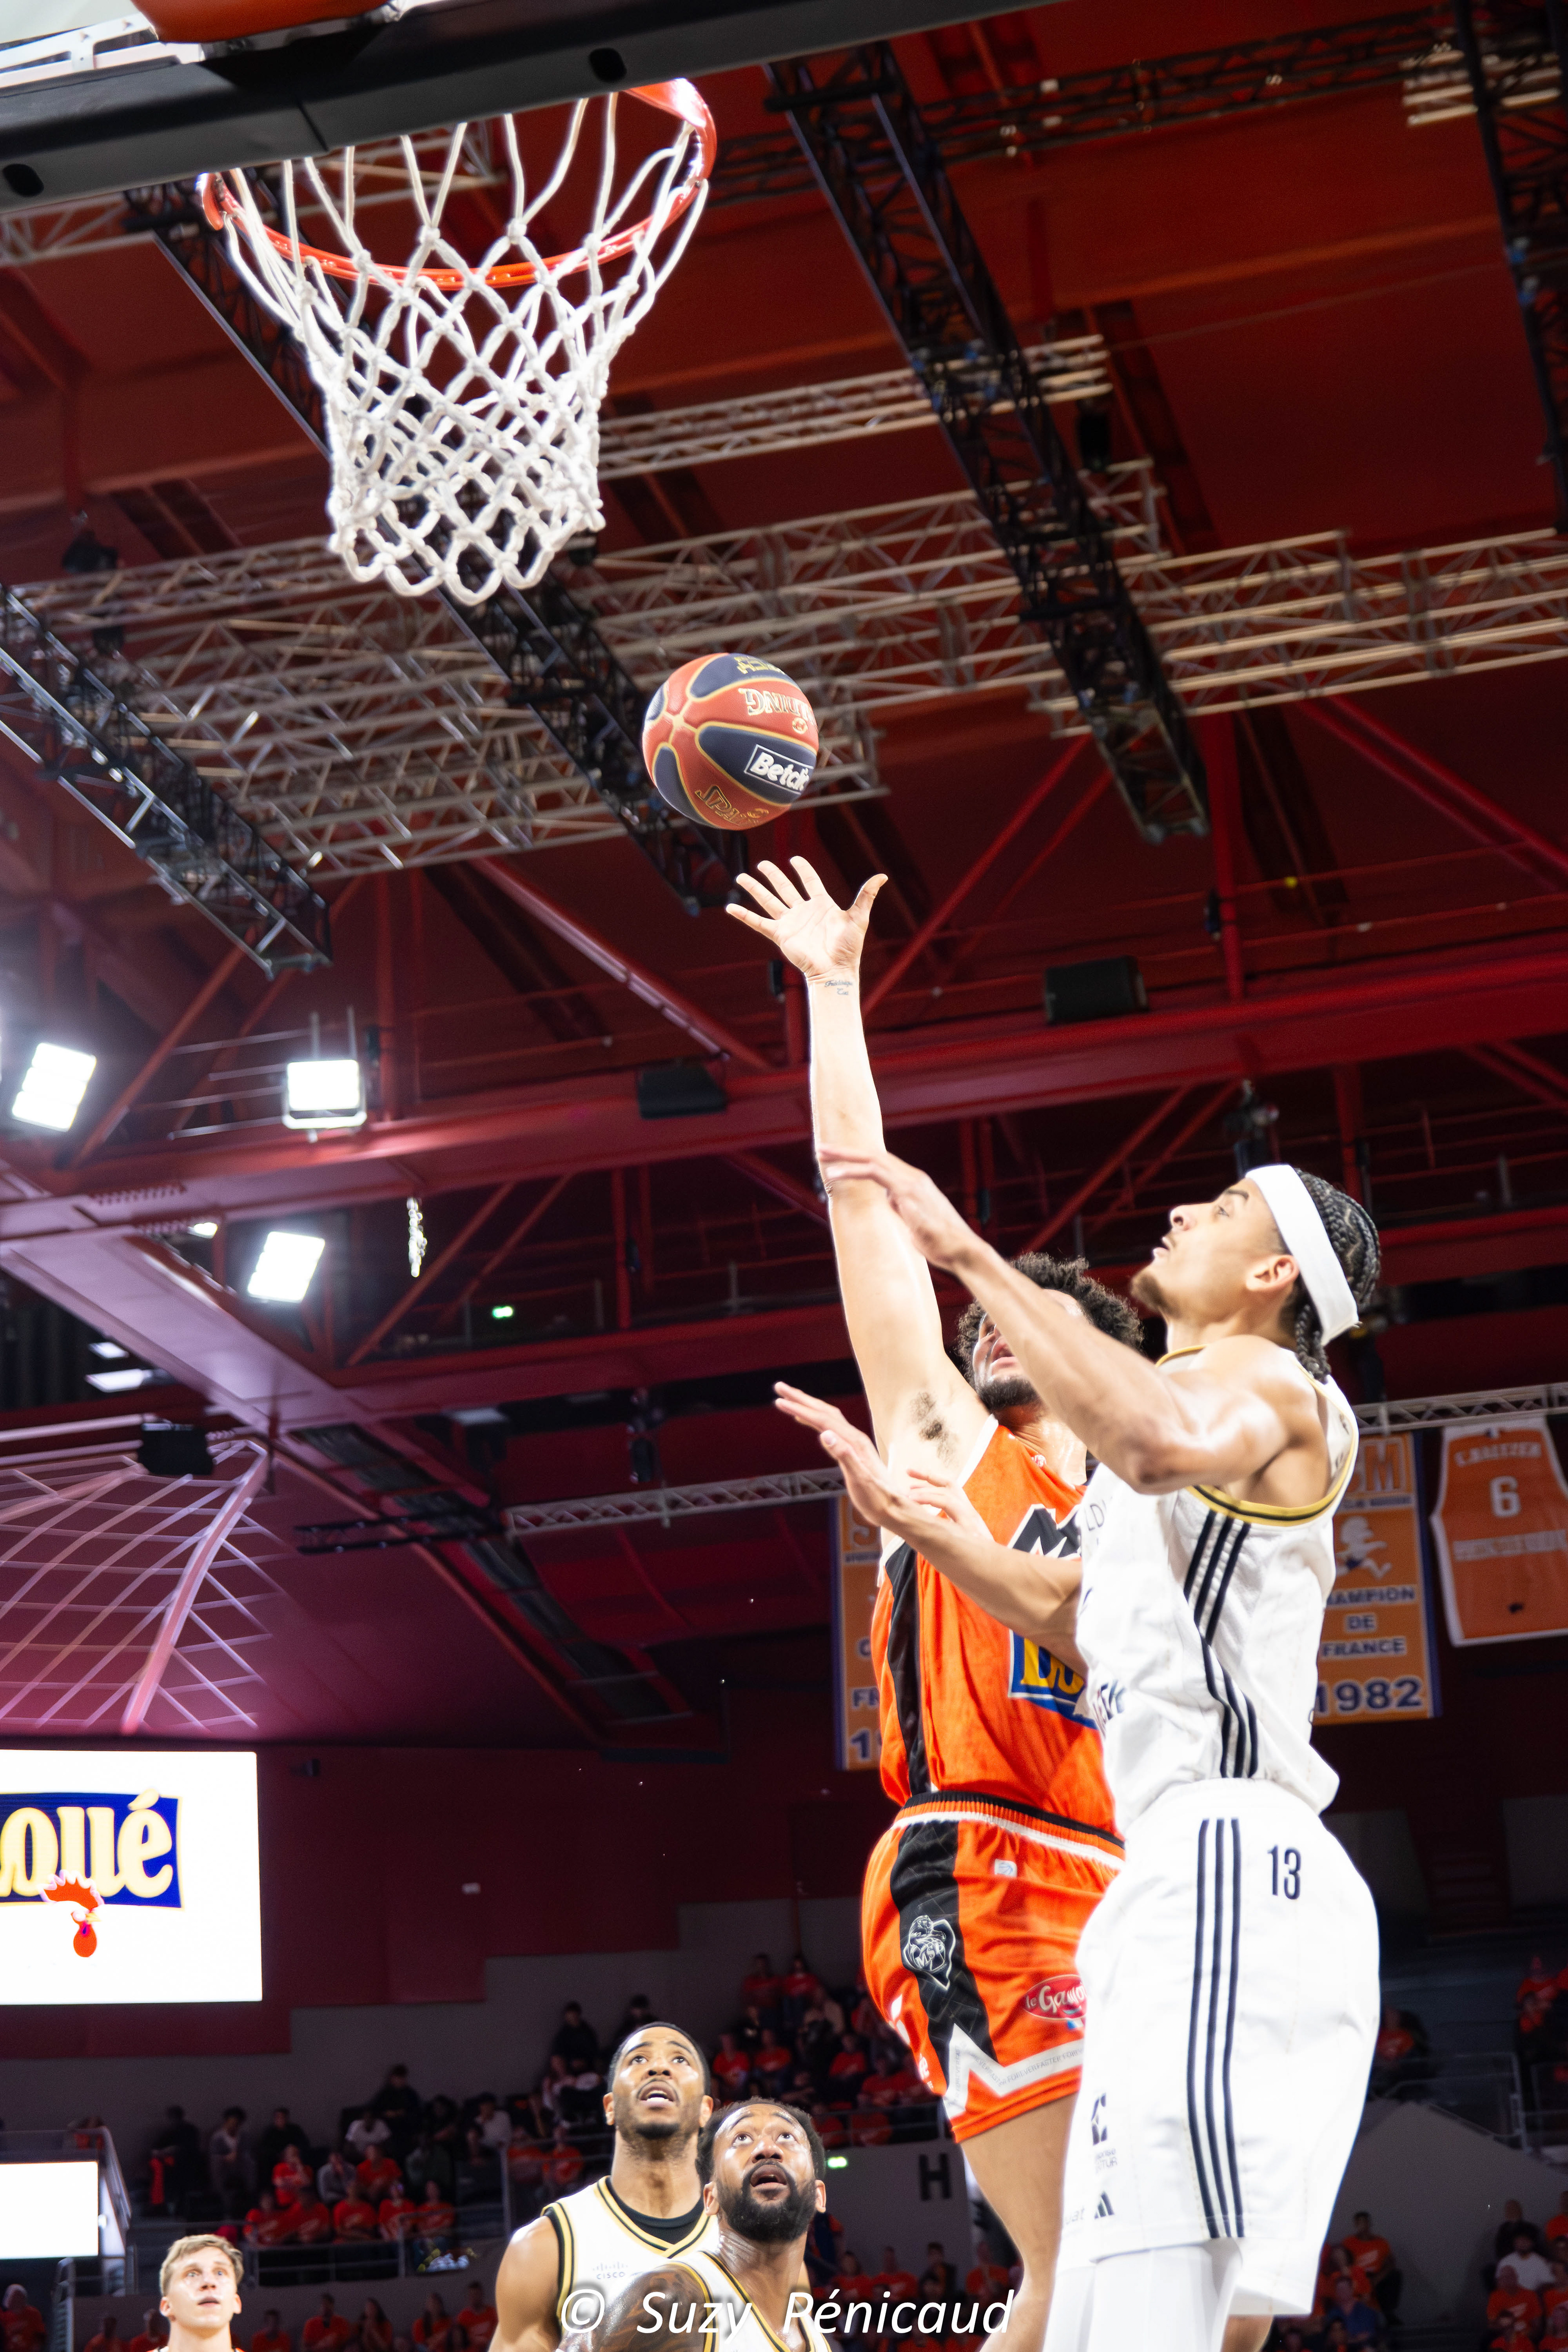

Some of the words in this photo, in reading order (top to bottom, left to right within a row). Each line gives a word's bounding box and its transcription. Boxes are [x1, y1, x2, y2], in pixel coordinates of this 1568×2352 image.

[1490, 1476, 1521, 1518] 6
[1346, 1614, 1376, 1630] DE
[1322, 1637, 1406, 1657] FRANCE
[0, 1788, 173, 1898] oué
[1267, 1844, 1301, 1900] 13
[919, 2153, 952, 2201] H
[597, 2271, 625, 2279] CISCO
